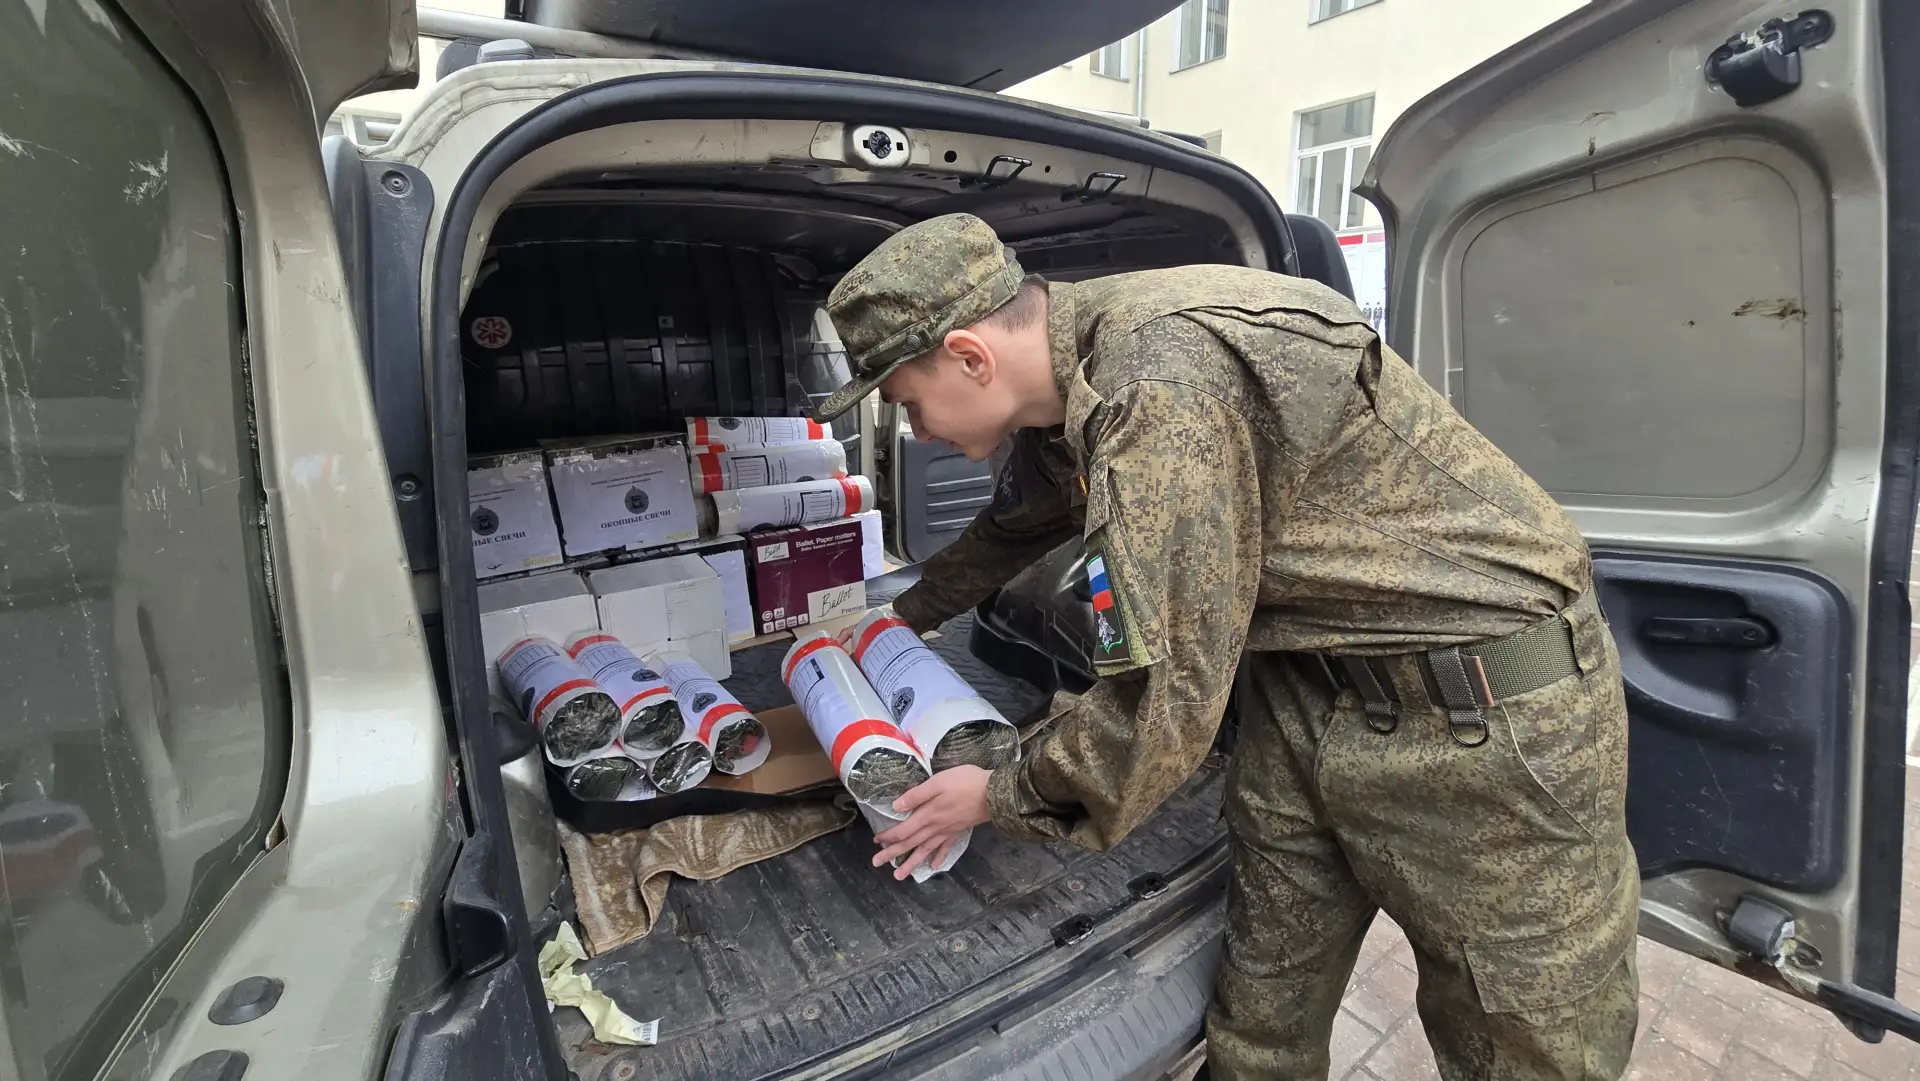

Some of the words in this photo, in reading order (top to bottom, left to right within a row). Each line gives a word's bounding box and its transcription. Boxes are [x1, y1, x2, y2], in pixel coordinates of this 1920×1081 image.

[601, 515, 643, 530] ОКОПНЫЕ
[645, 509, 672, 521] СВЕЧИ
[472, 537, 493, 548] НЫЕ
[494, 531, 527, 543] СВЕЧИ
[816, 536, 834, 544] Paper
[818, 586, 854, 618] Ballet
[841, 604, 866, 615] Premier
